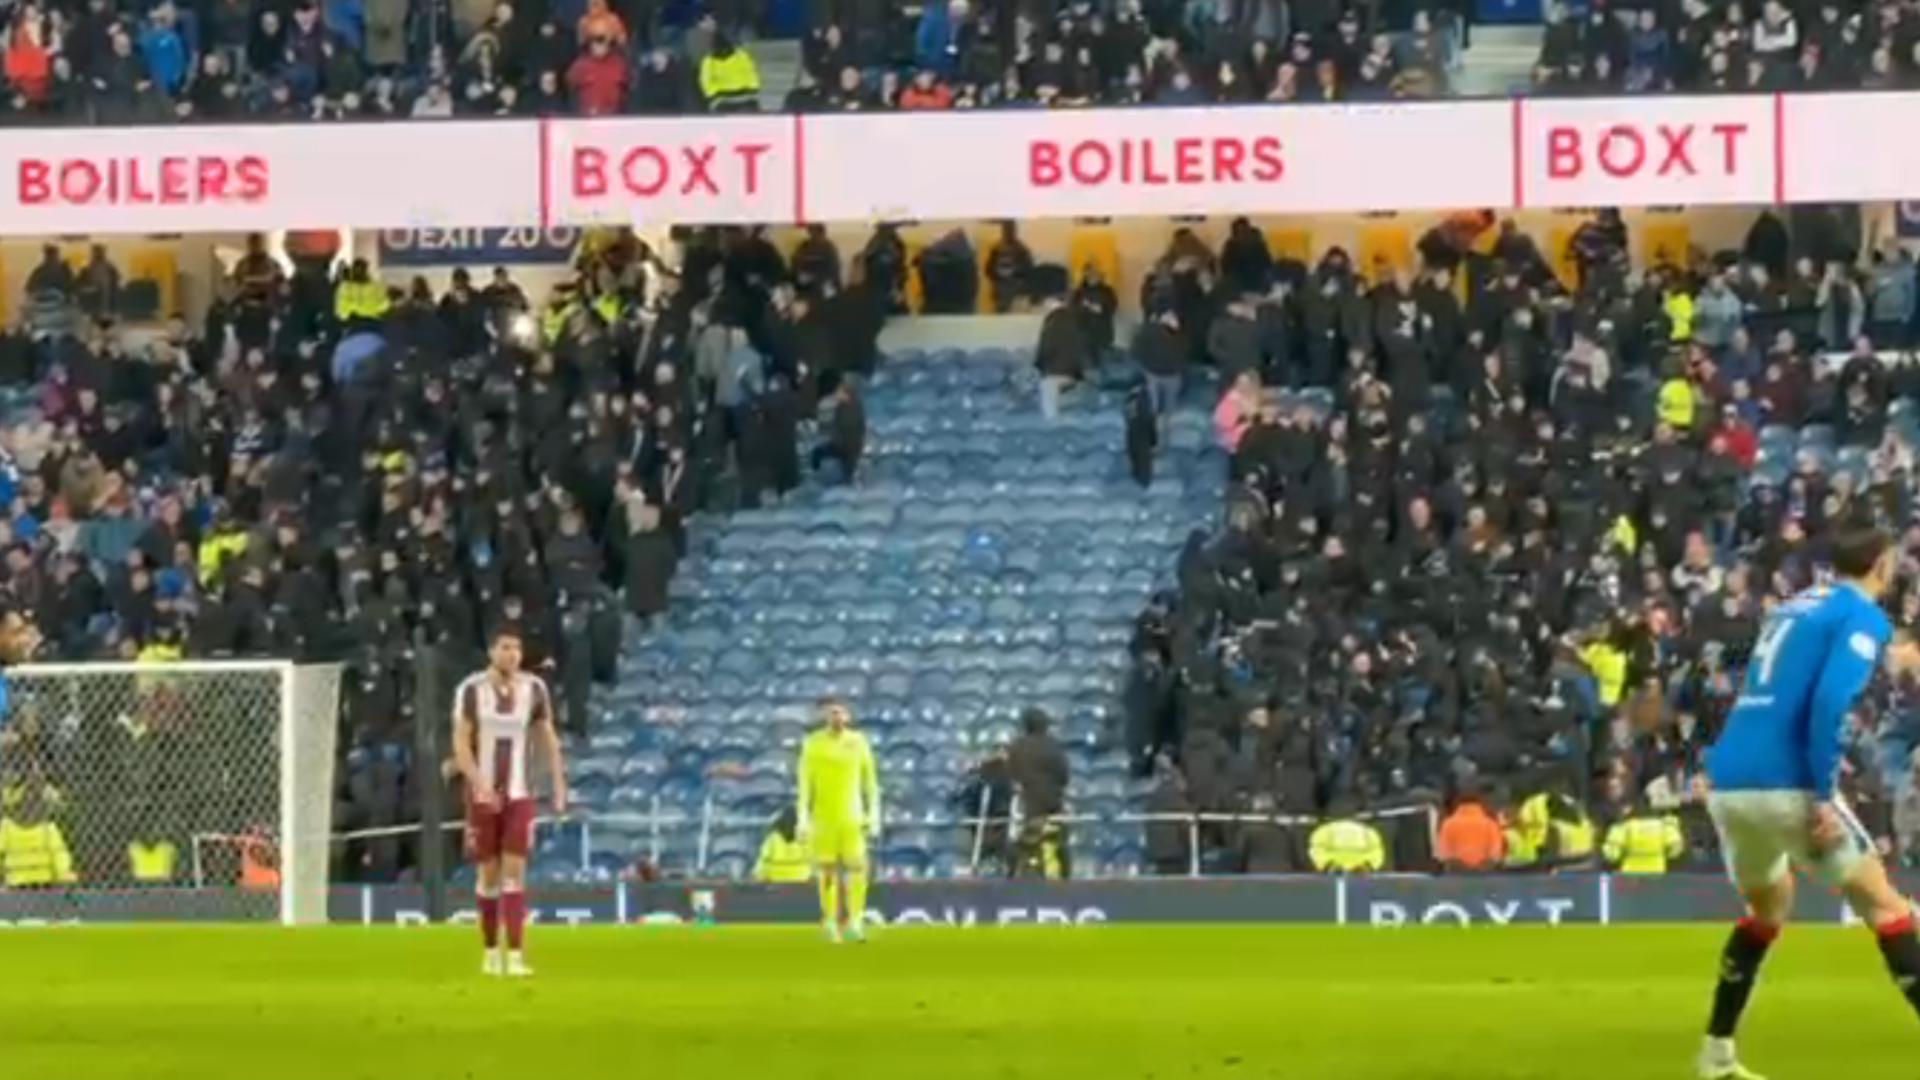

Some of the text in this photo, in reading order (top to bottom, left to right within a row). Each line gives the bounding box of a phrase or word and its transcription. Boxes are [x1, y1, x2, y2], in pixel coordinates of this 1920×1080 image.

[573, 144, 771, 197] BOXT
[1029, 137, 1285, 186] BOILERS
[1547, 124, 1747, 179] BOXT
[18, 155, 269, 206] BOILERS
